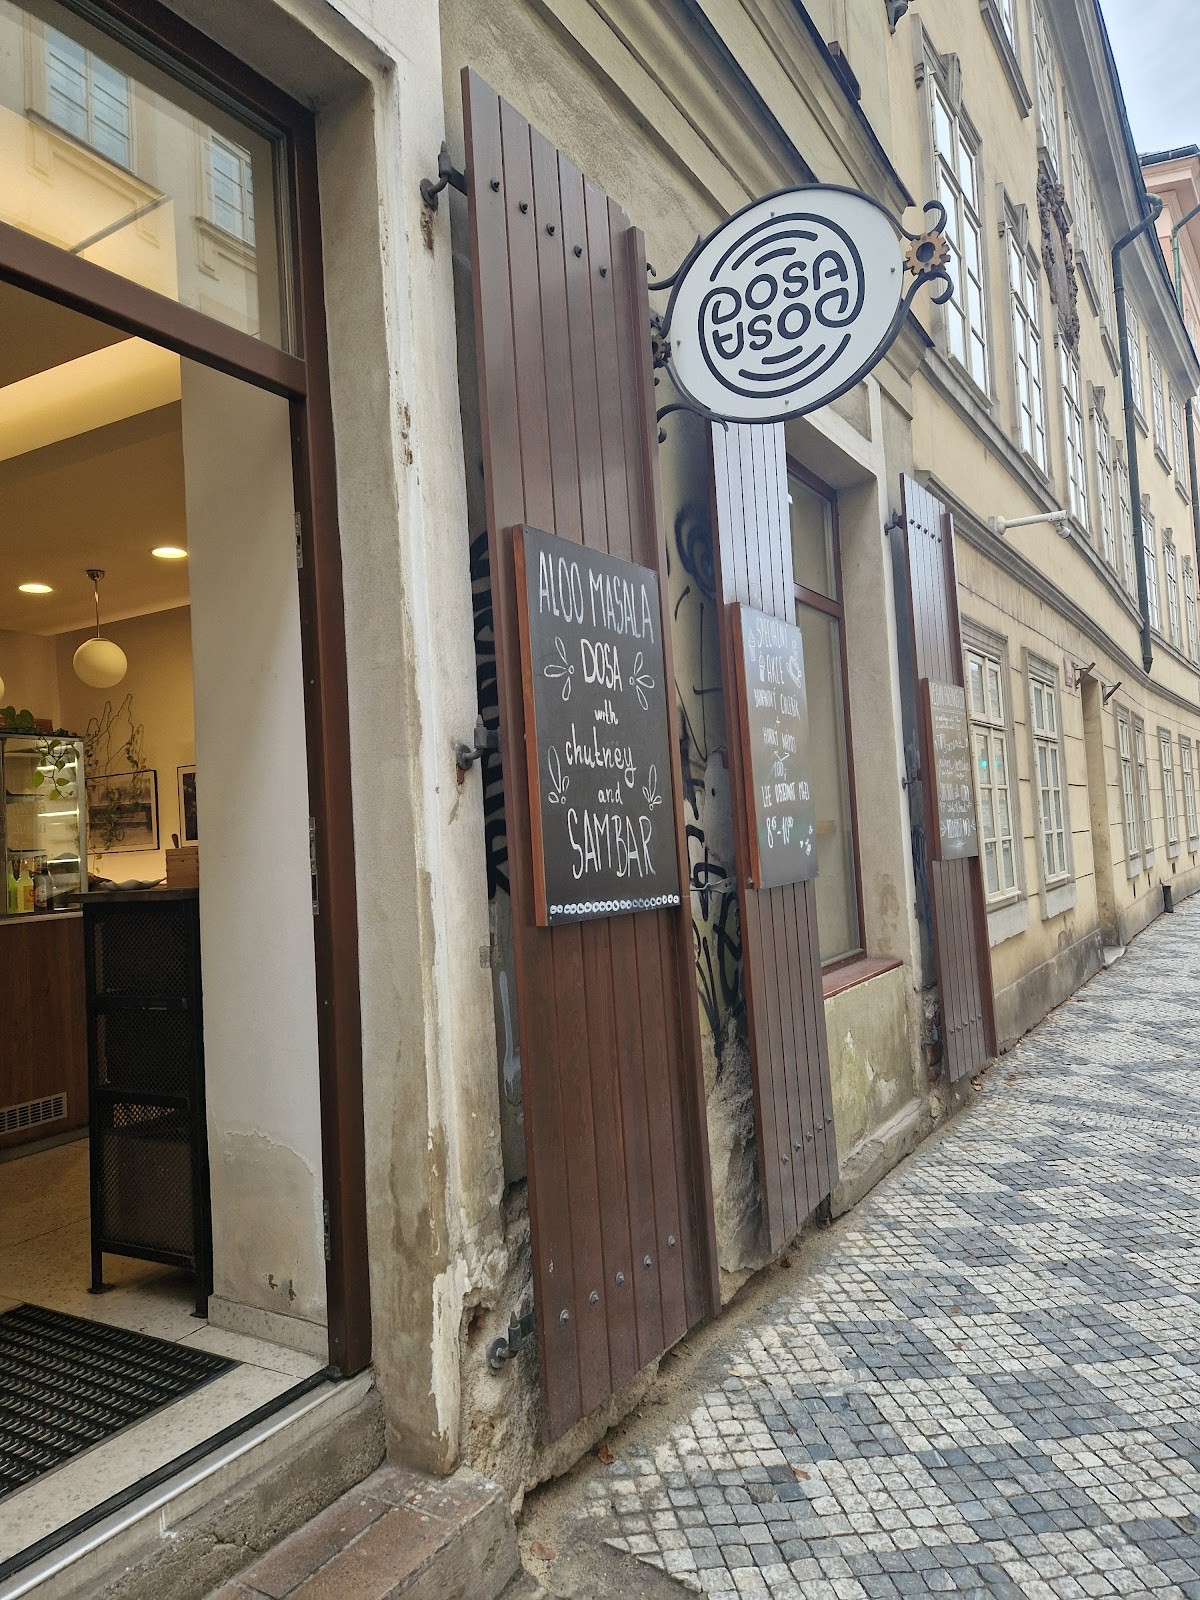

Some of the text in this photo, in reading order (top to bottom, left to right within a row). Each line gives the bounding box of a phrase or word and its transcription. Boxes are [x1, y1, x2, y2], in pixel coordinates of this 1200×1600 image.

[699, 249, 849, 326] DOSA
[711, 287, 864, 361] DOSA
[538, 549, 655, 645] ALOO MASALA
[580, 637, 624, 693] DOSA
[594, 699, 619, 726] with
[565, 722, 637, 789] chutney
[598, 782, 624, 805] and
[566, 807, 656, 881] SAMBAR
